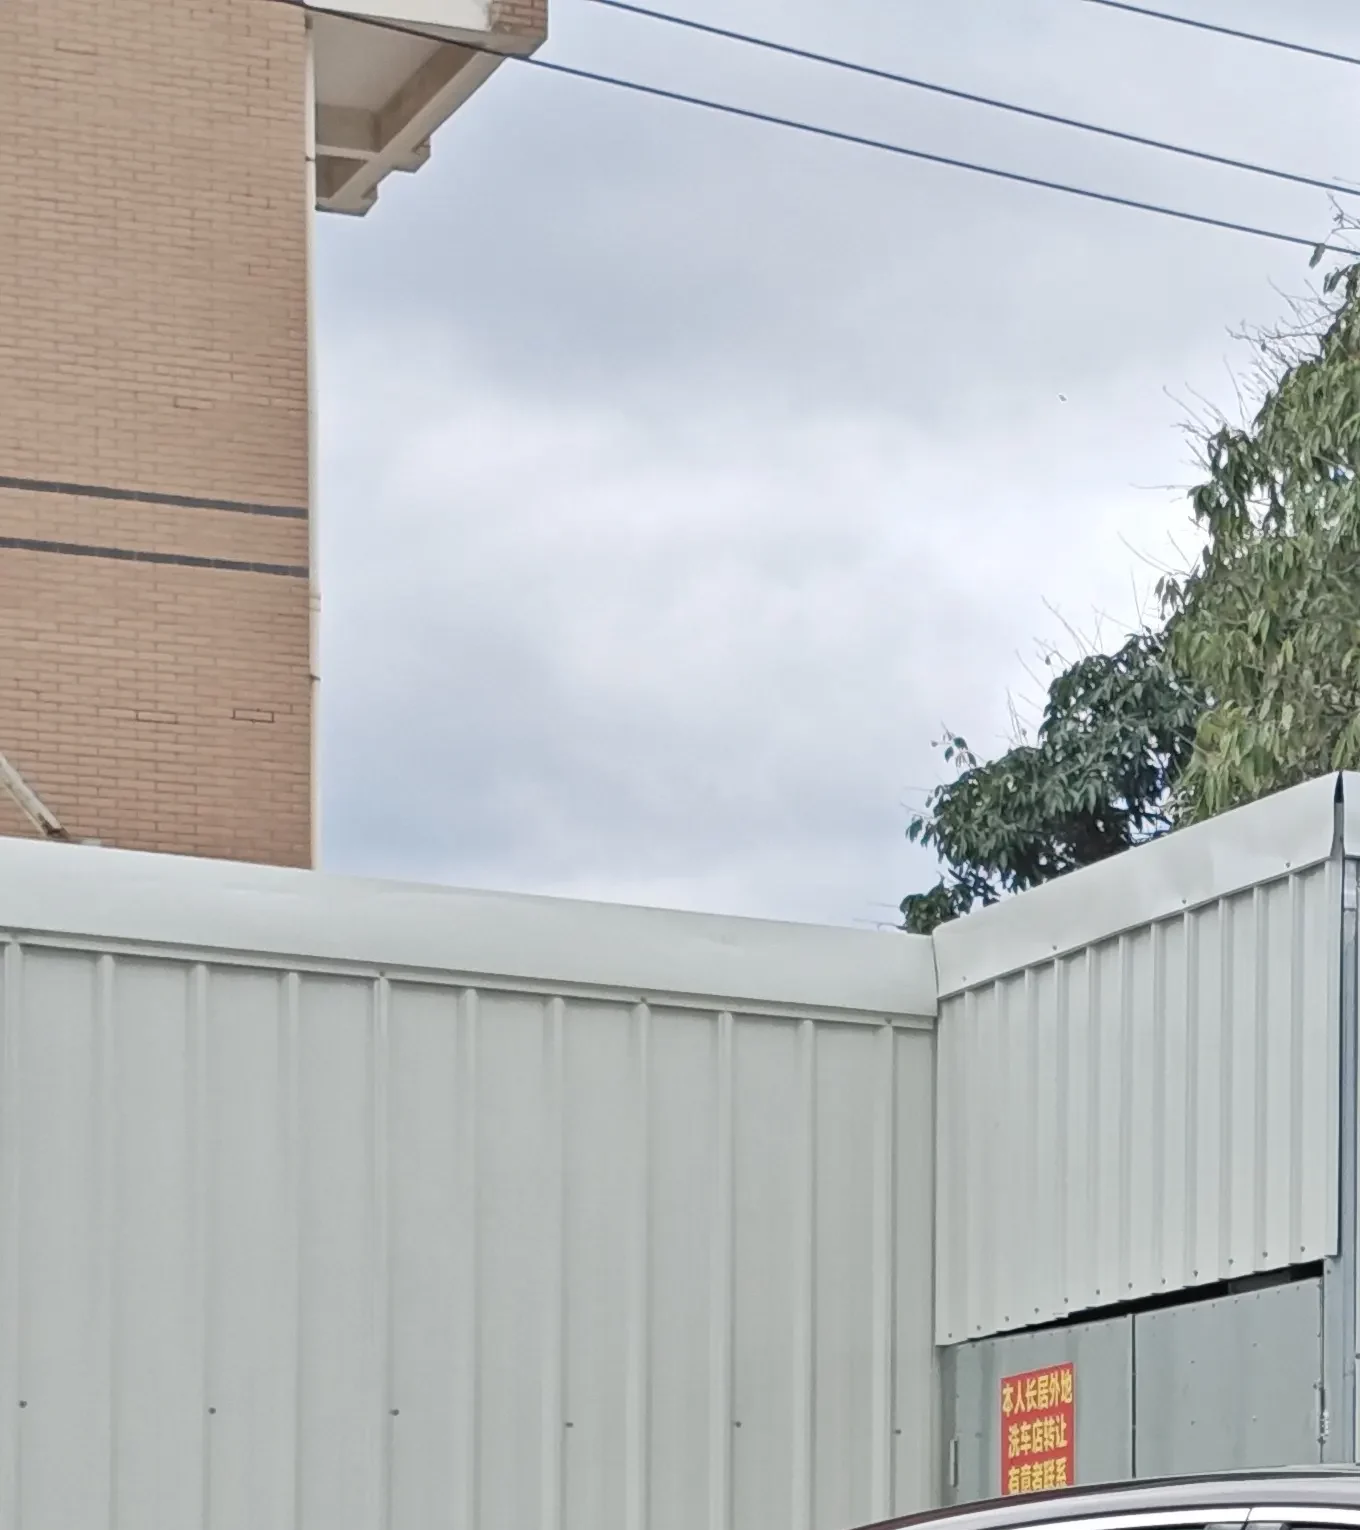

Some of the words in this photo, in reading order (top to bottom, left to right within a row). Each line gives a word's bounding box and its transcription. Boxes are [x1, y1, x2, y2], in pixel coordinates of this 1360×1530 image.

[1002, 1369, 1073, 1417] 本人长居外地
[1008, 1413, 1067, 1458] 洗车店转让
[1007, 1457, 1067, 1493] 有意者联系
